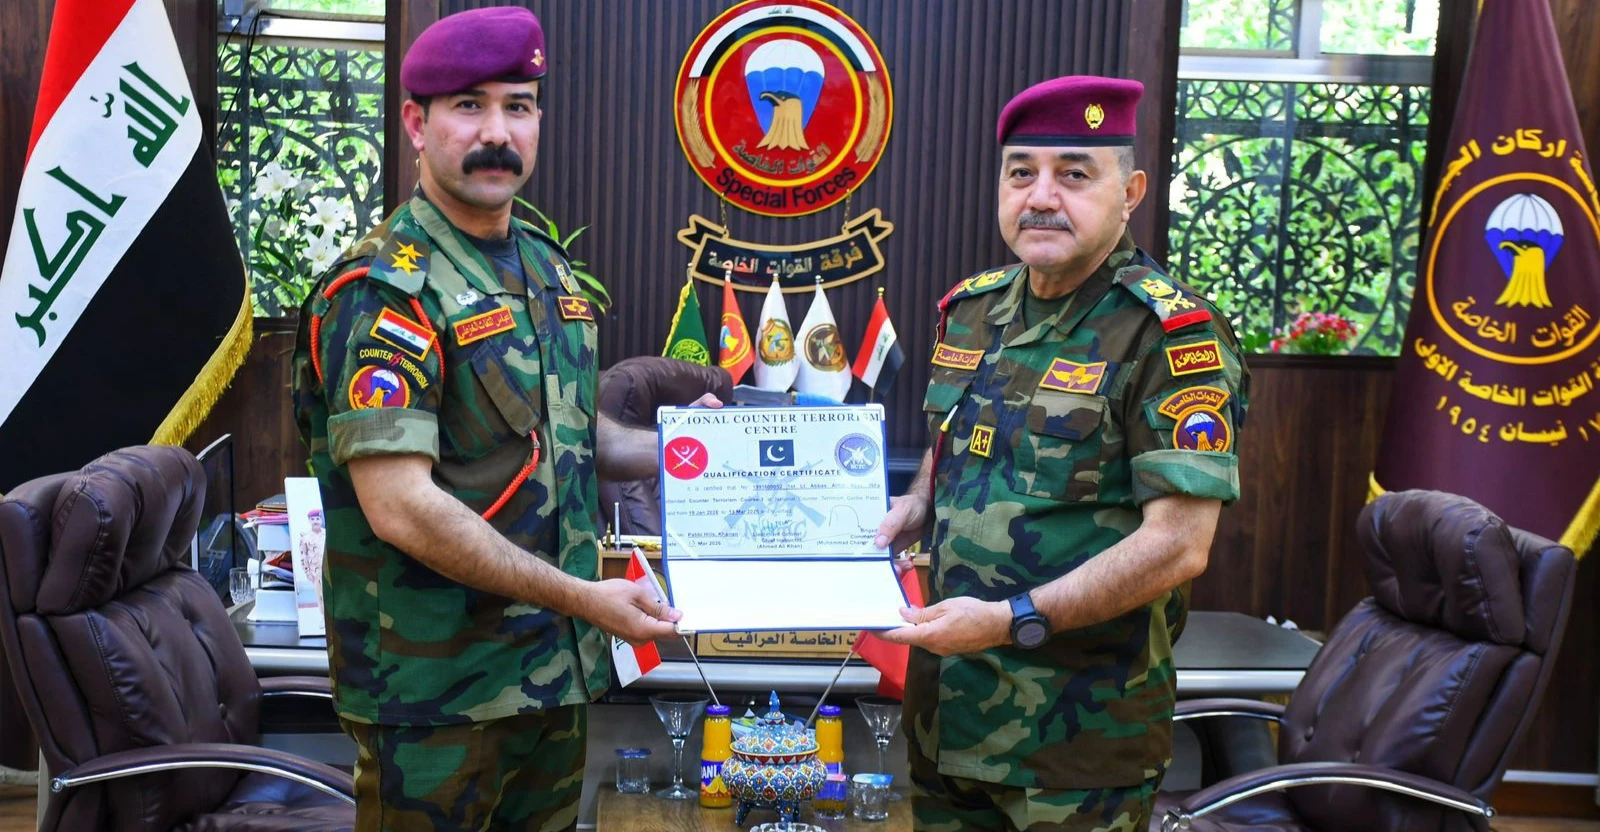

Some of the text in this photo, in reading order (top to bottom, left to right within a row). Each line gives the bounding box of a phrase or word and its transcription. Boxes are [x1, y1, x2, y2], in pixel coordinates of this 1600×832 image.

[90, 61, 190, 168] الله
[732, 139, 832, 175] القوات الخاصة
[1491, 128, 1568, 158] اركان
[716, 166, 857, 209] Special Forces
[708, 241, 864, 279] فرقة القوات الخاصة
[1452, 296, 1591, 347] القوات الخاصة
[359, 348, 429, 390] COUNTER TERRORISM
[1458, 370, 1527, 407] الخاصة
[1532, 371, 1593, 406] القوات
[733, 413, 797, 424] COUNTER
[744, 425, 798, 435] CENTRE
[1499, 420, 1568, 446] نيسان
[974, 430, 989, 450] A+
[703, 469, 841, 478] QUALIFICATION CERTIFICATE
[789, 631, 842, 646] الخاصة
